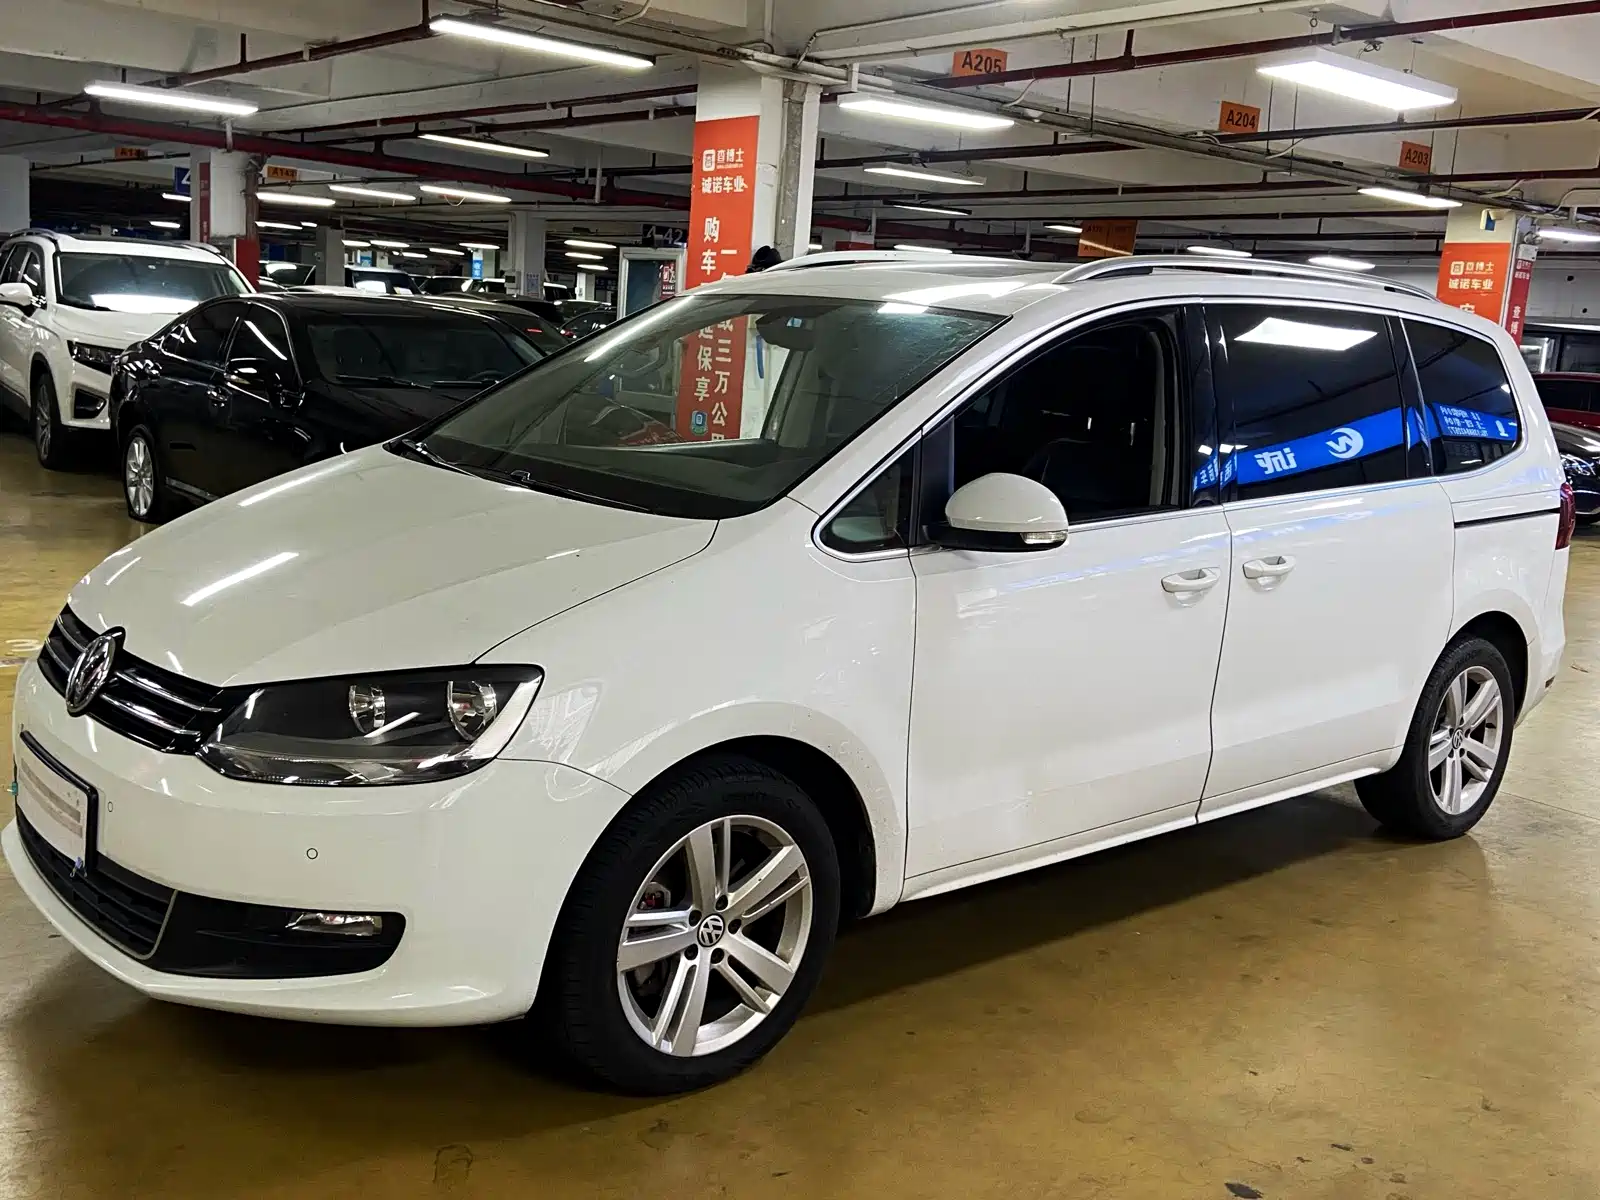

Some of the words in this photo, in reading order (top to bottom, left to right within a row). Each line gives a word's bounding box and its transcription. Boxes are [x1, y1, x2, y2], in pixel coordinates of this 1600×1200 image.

[962, 51, 1002, 73] A205
[1225, 109, 1256, 129] A204
[1404, 147, 1429, 166] A203
[701, 175, 749, 194] 诚诺车业
[1448, 278, 1494, 290] 诚诺车业
